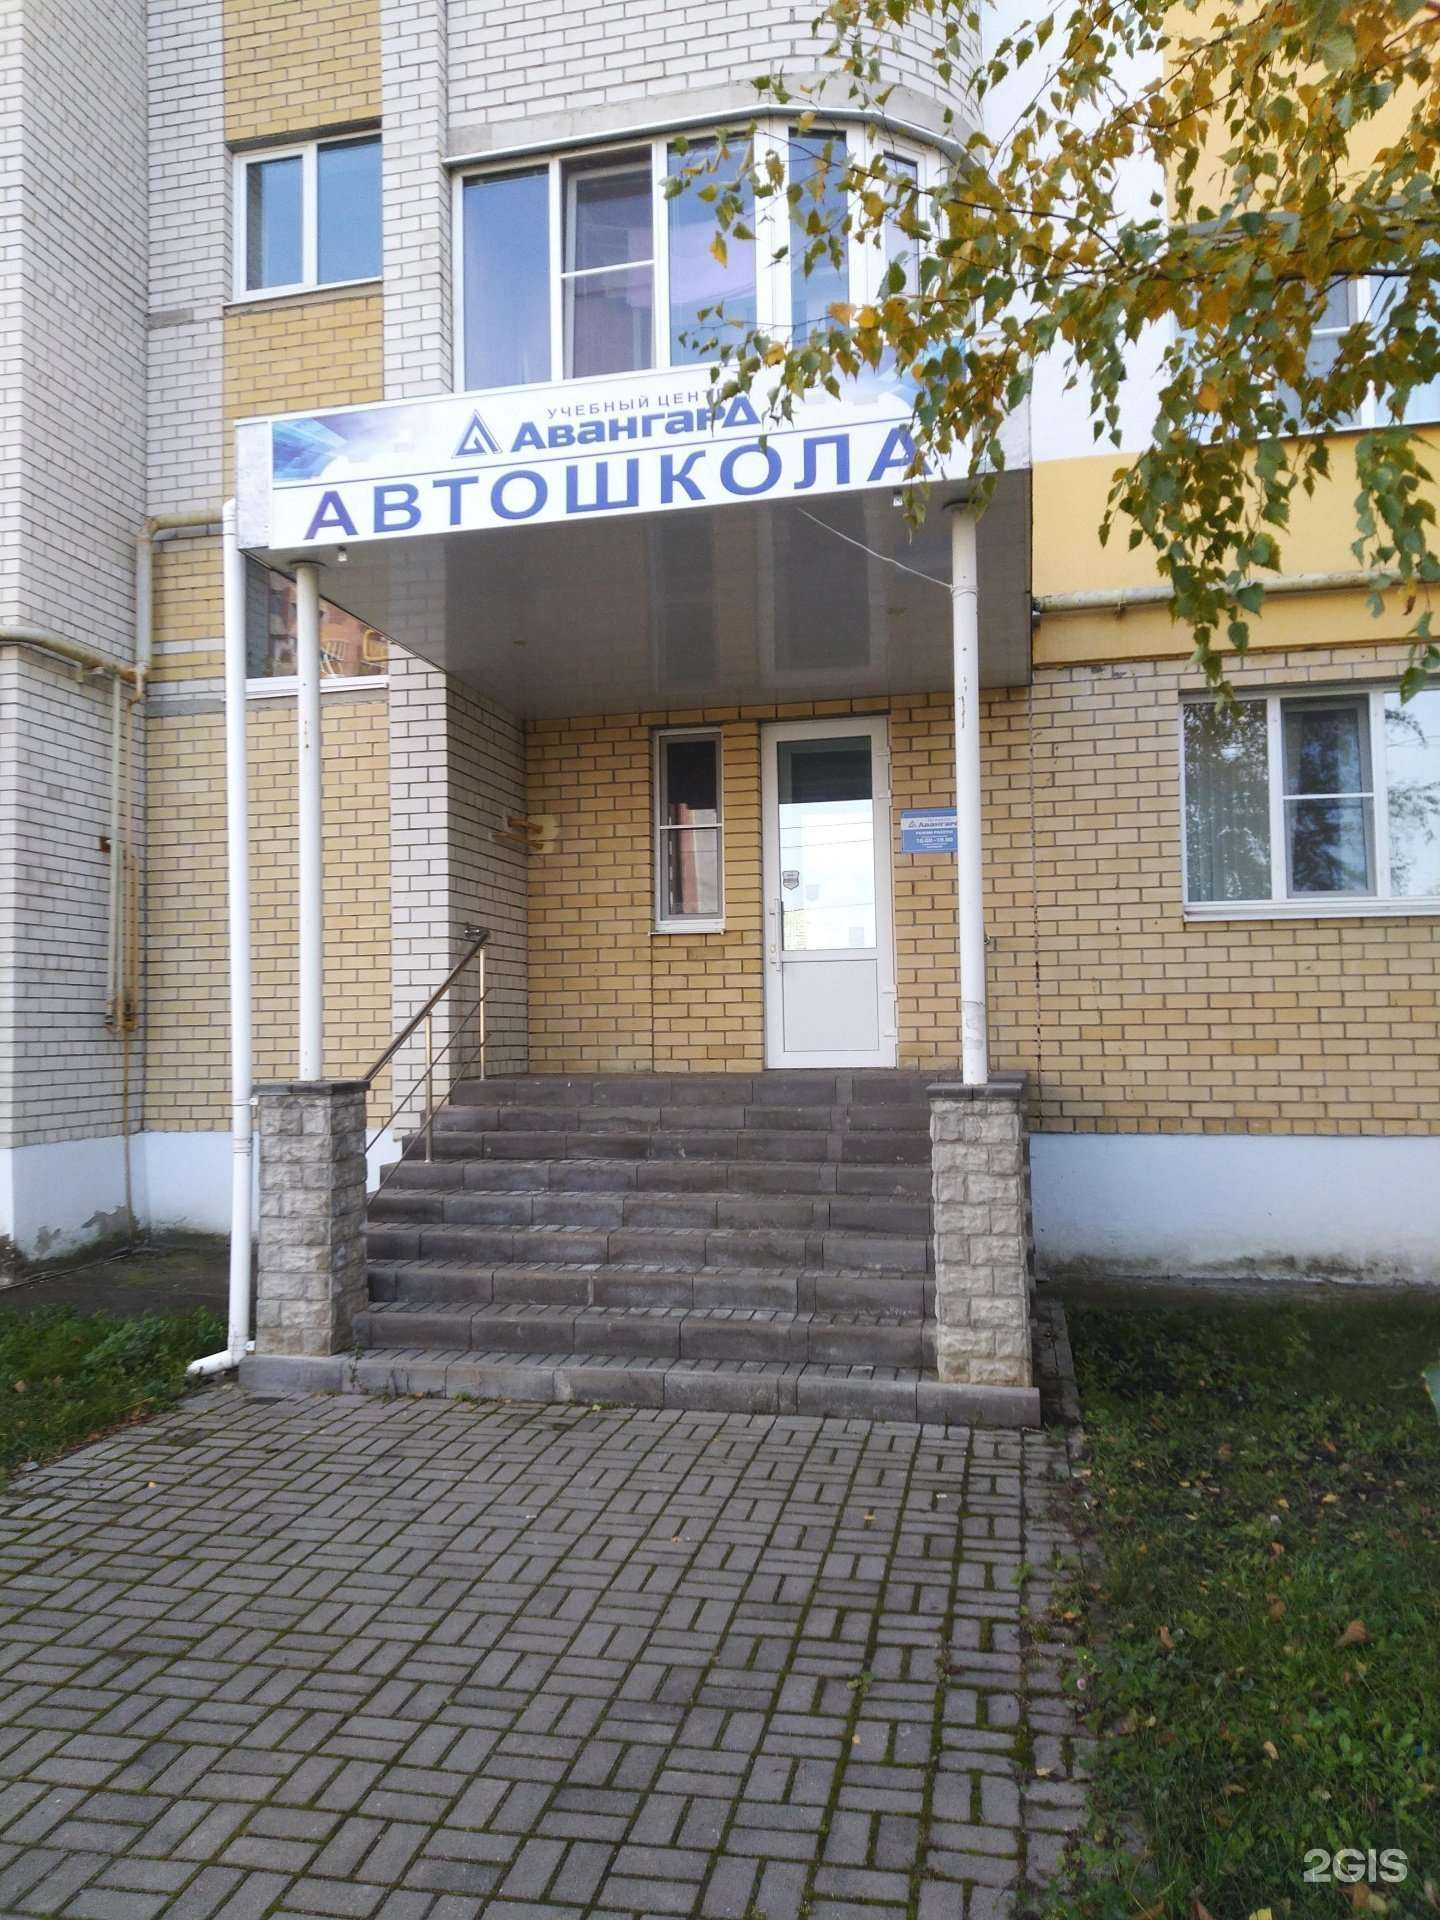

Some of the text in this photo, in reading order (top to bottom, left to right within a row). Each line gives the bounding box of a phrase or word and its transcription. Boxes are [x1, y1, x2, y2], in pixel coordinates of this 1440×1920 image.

[547, 388, 724, 419] УЧЕБНЫЙ ЦЕН
[303, 427, 934, 540] АВТОШКОЛА
